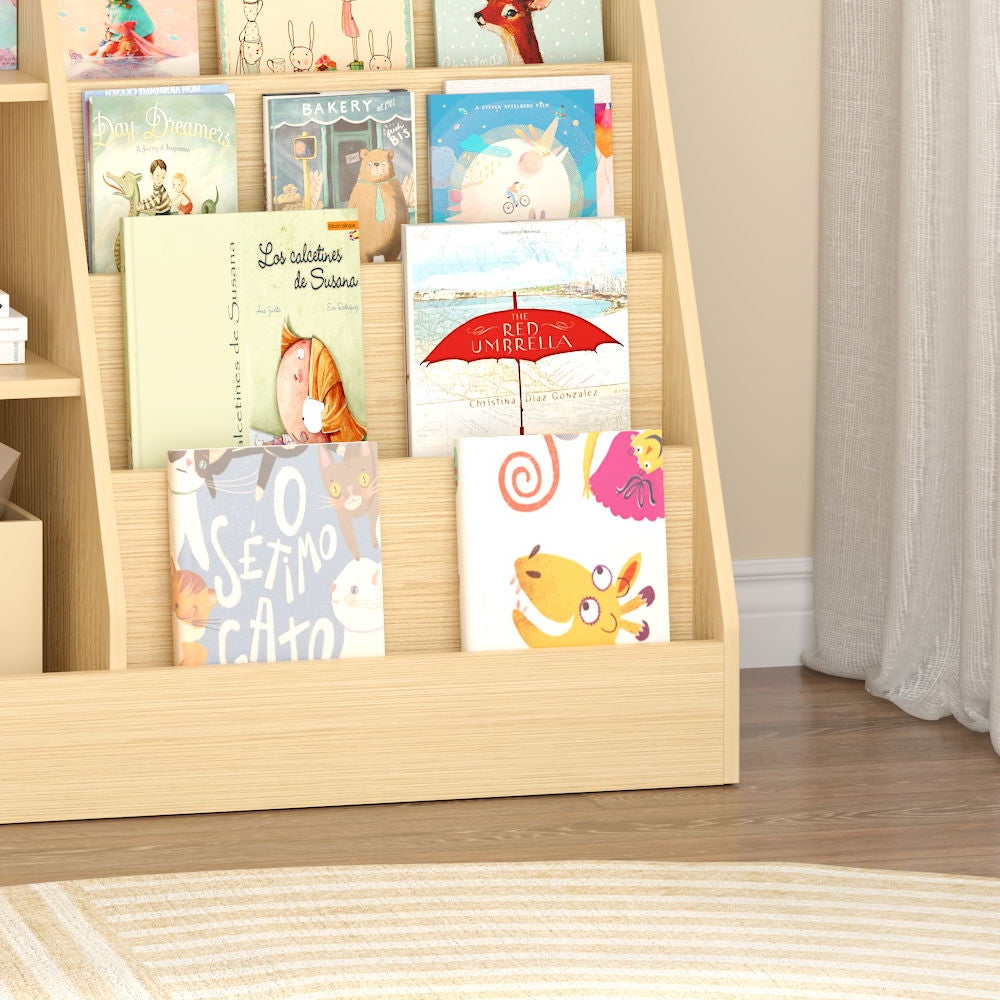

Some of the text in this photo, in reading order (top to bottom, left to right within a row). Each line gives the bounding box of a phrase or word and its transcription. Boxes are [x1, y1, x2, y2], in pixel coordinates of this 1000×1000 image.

[302, 99, 372, 116] BAKERY
[92, 102, 231, 151] Day Dreamers
[257, 241, 343, 269] Los calcetines
[227, 241, 240, 323] Susana
[294, 267, 359, 290] de Susana
[511, 312, 529, 321] THE
[503, 322, 539, 337] RED
[229, 330, 240, 355] de
[471, 334, 573, 354] UMBRELLA
[469, 389, 598, 409] Christina Diaz Gonzalez
[273, 465, 307, 537] O
